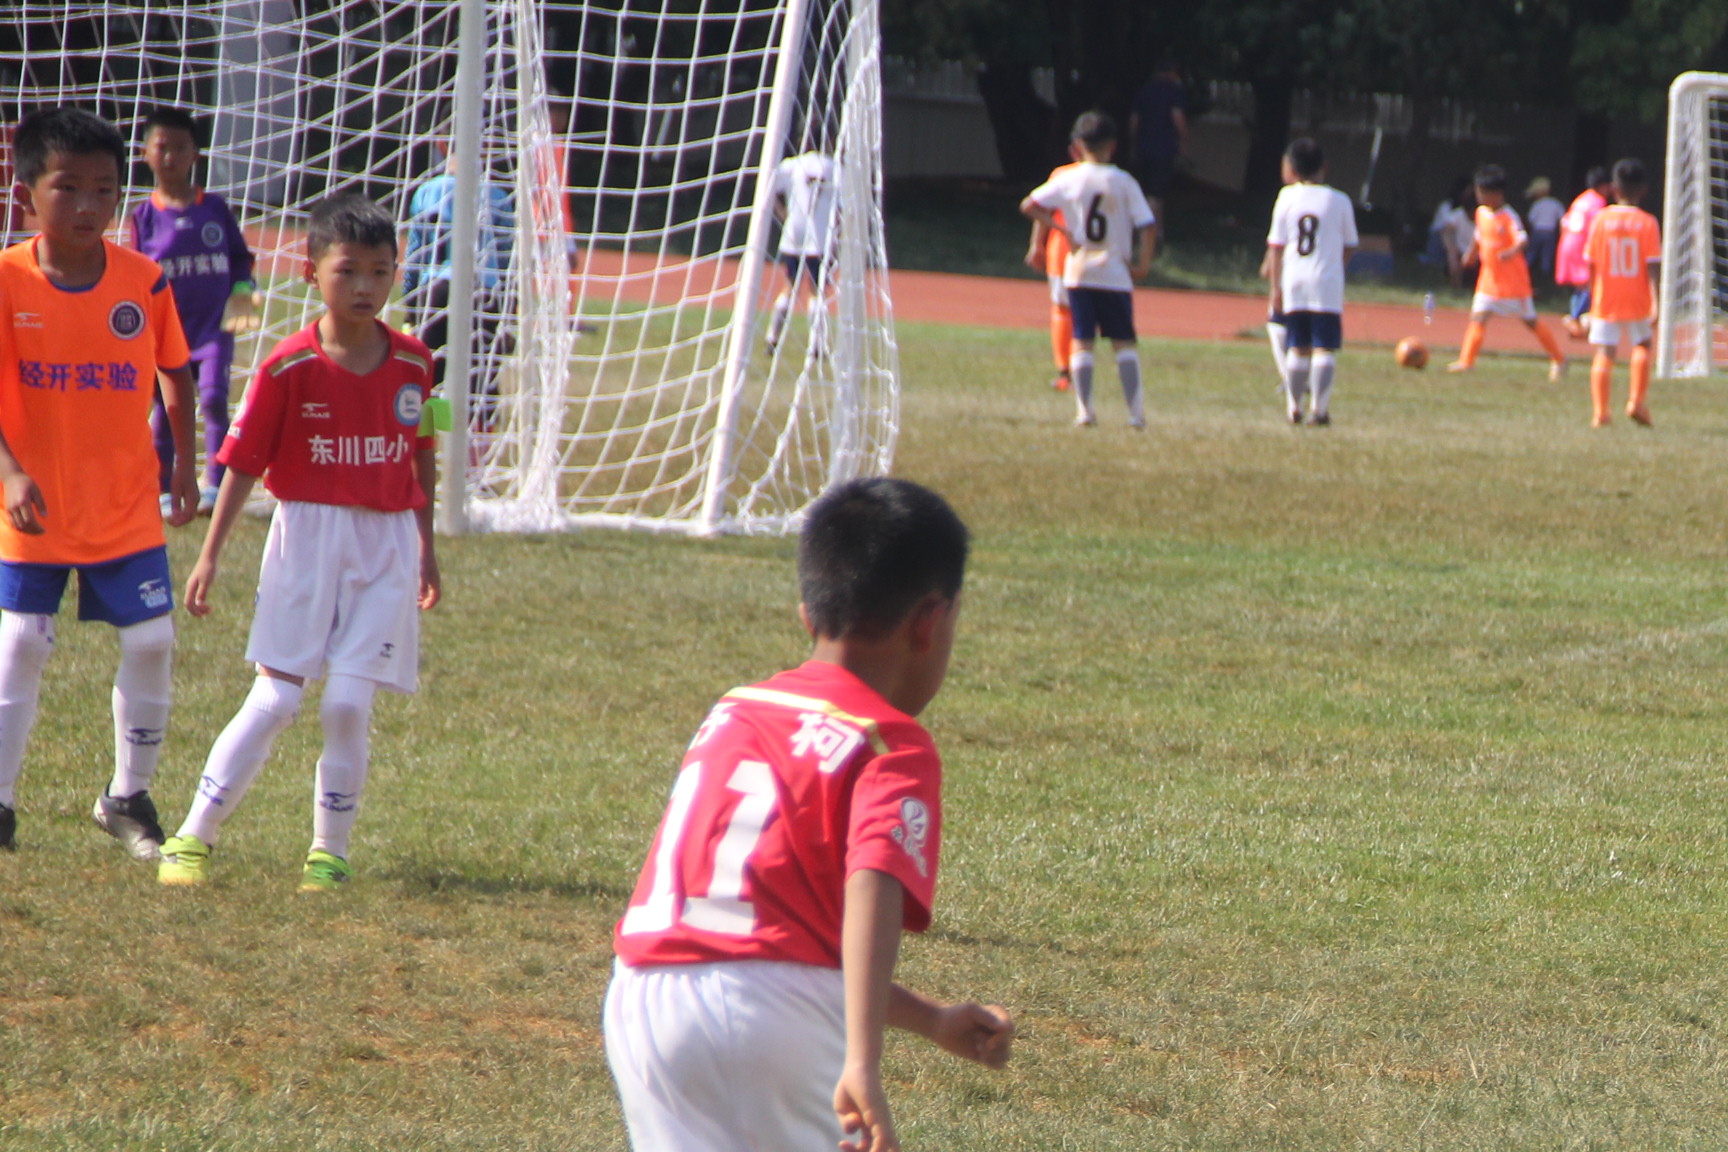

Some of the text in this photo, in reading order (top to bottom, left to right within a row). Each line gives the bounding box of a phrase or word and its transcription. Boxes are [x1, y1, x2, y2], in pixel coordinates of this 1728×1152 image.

[1086, 193, 1107, 242] 6
[1299, 214, 1318, 256] 8
[1609, 237, 1640, 278] 10
[20, 360, 138, 391] 经开实验
[308, 435, 408, 466] 东川四小
[621, 759, 779, 936] 11
